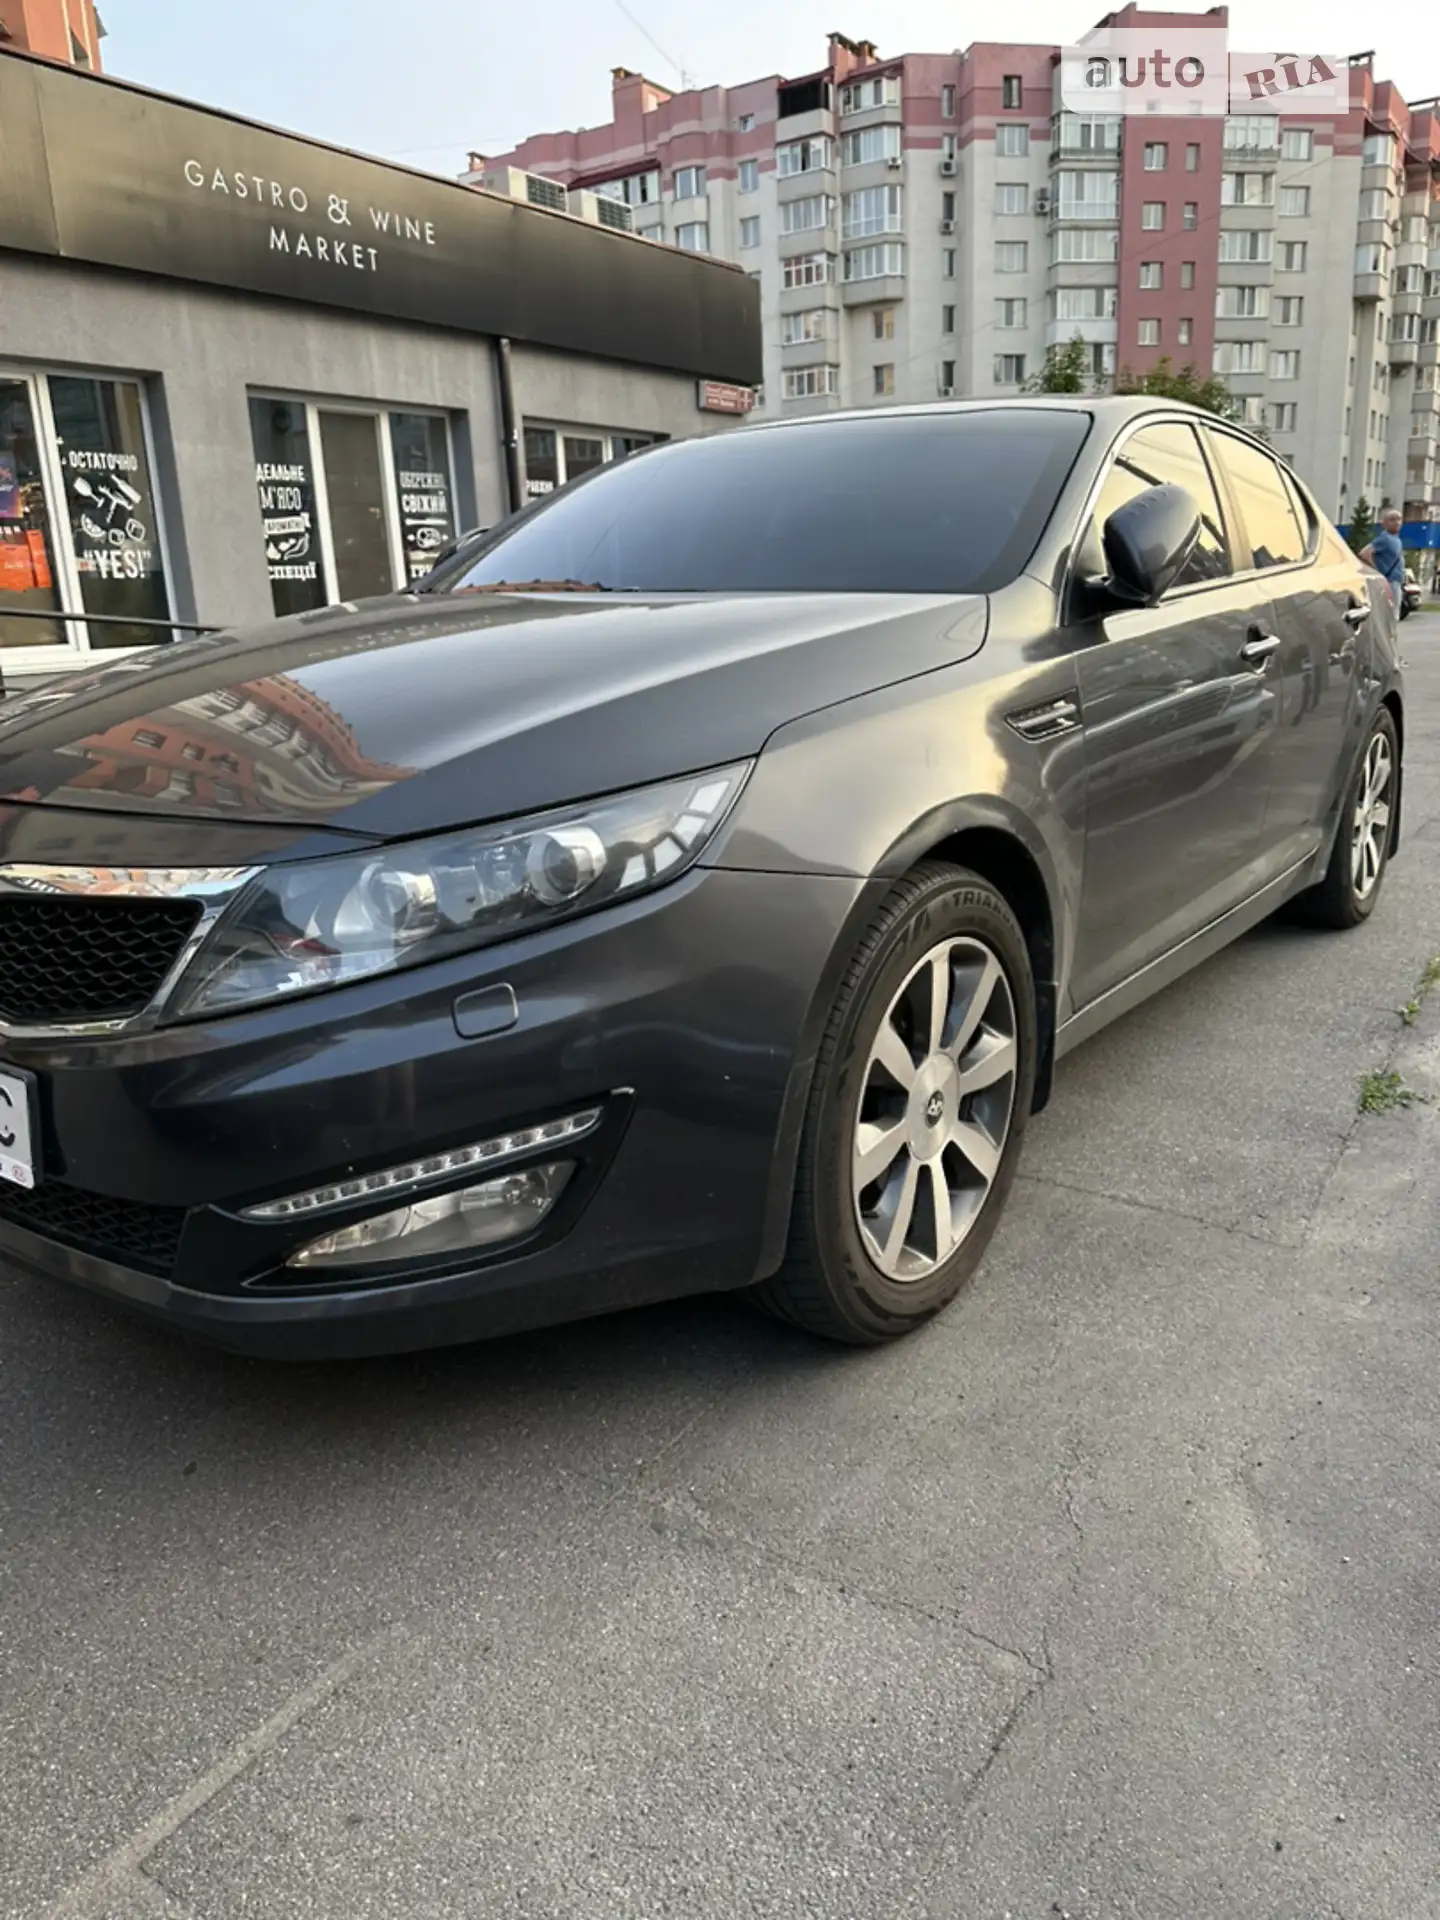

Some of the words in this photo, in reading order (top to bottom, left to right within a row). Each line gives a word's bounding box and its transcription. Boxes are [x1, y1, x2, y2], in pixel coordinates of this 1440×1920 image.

[183, 159, 309, 213] GASTRO
[327, 193, 352, 226] &
[369, 206, 436, 246] WINE
[269, 226, 379, 272] MARKET
[68, 450, 139, 472] ОСТАТОЧНО
